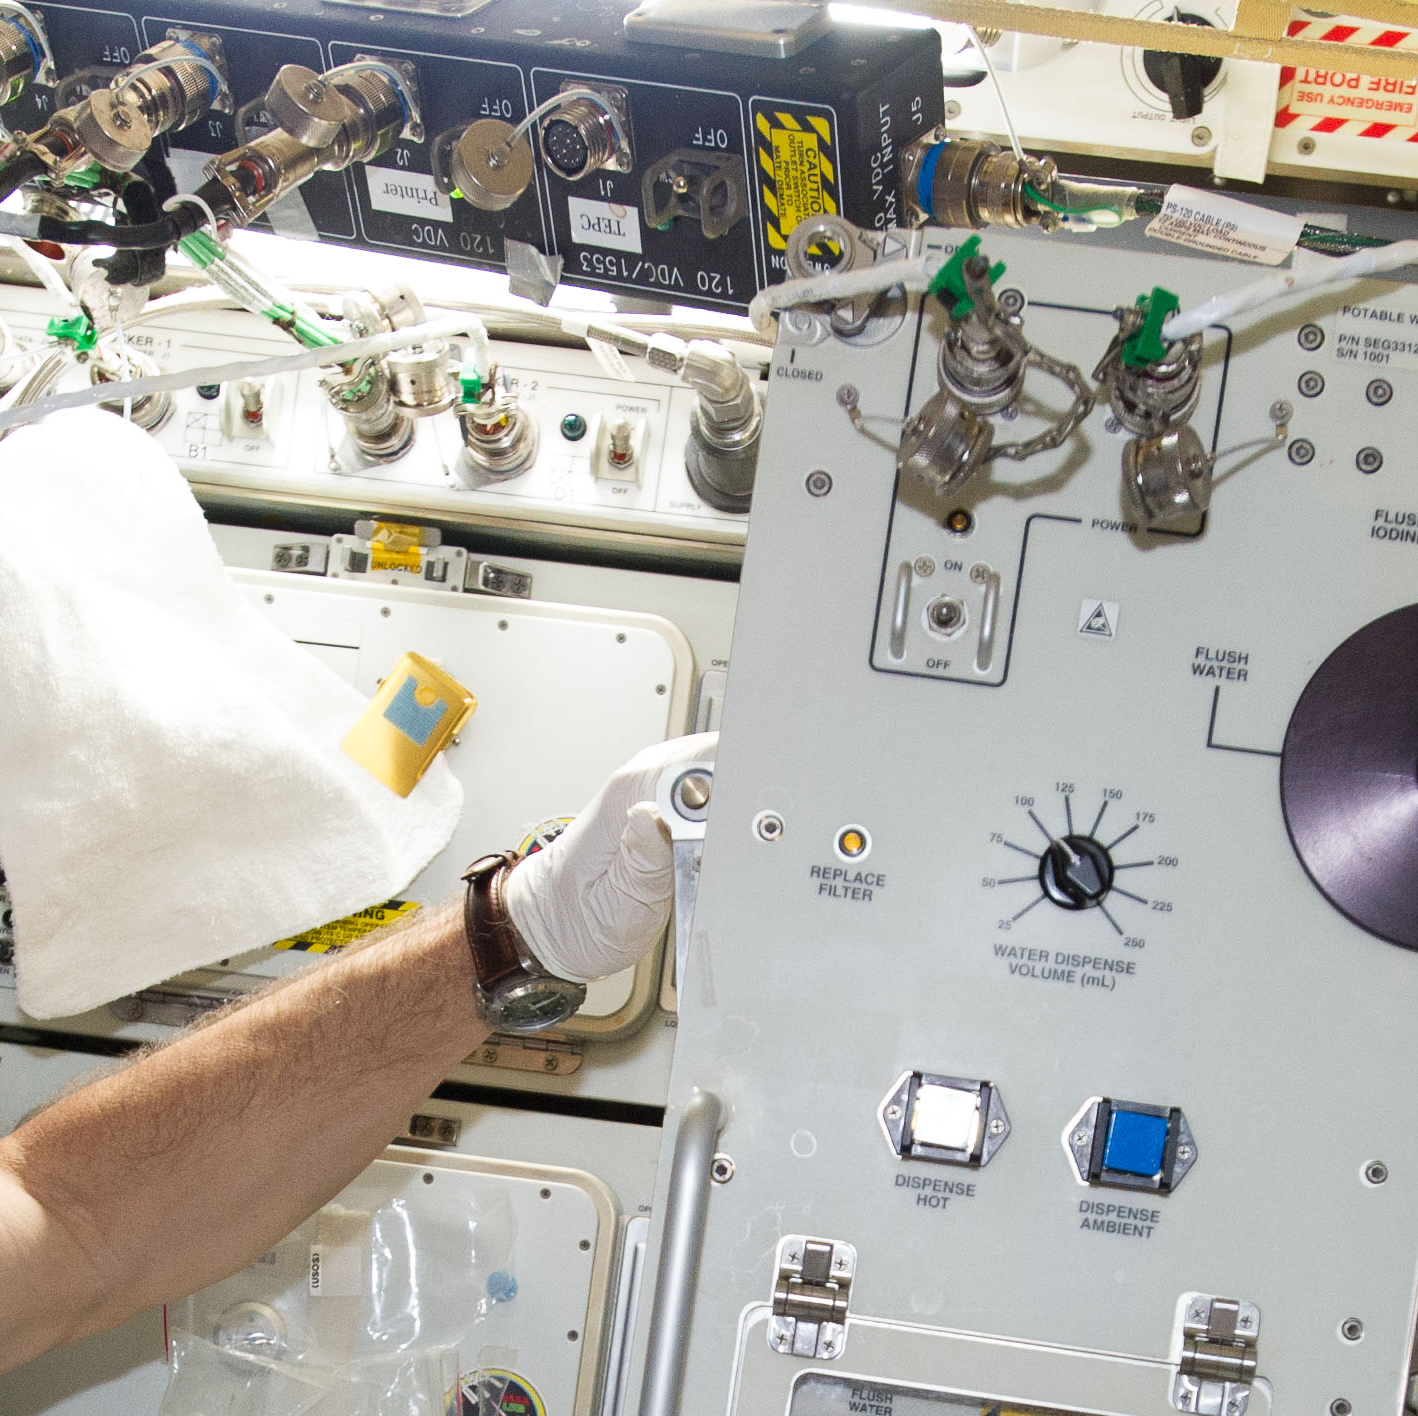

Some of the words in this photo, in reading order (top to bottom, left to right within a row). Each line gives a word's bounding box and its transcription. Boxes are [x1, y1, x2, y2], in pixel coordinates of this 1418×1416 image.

[103, 44, 130, 65] OFF
[1299, 67, 1361, 90] PORT
[1295, 90, 1325, 106] USE
[1328, 97, 1414, 114] EMERGENCY
[480, 97, 512, 119] OFF
[911, 96, 923, 125] J5
[691, 127, 728, 149] OFF
[879, 103, 894, 174] INPUT
[395, 148, 410, 165] J2
[871, 152, 883, 200] VDC
[382, 181, 439, 207] Printer
[599, 179, 614, 197] J1
[1165, 202, 1193, 219] PS-120
[1193, 211, 1222, 229] CABLE
[580, 214, 626, 237] TEPC
[411, 223, 449, 248] VDC
[459, 232, 495, 255] 120
[579, 252, 684, 287] VDC/1553
[697, 270, 735, 295] 120
[1342, 306, 1405, 324] POTABLE
[1338, 333, 1360, 347] P/N
[1336, 346, 1358, 360] S/N
[1362, 350, 1391, 364] 1001
[775, 367, 823, 382] CLOSED
[1090, 518, 1139, 535] POWER
[943, 559, 964, 572] ON
[925, 657, 953, 673] OFF
[1193, 647, 1250, 667] FLUSH
[1191, 662, 1250, 684] WATER
[1053, 782, 1075, 795] 125
[1101, 788, 1124, 802] 150
[1013, 794, 1036, 809] 100
[1133, 811, 1157, 825] 175
[988, 832, 1005, 845] 75
[1156, 855, 1180, 869] 200
[809, 864, 887, 888] REPLACE
[981, 876, 997, 889] 50
[817, 883, 874, 902] FILTER
[1151, 900, 1174, 914] 225
[997, 919, 1013, 932] 25
[1123, 936, 1146, 950] 250
[992, 943, 1050, 966] WATER
[1054, 951, 1137, 977] DISPENSE
[1008, 962, 1077, 985] VOLUME
[1080, 970, 1118, 992] (mL)
[893, 1172, 977, 1198] DISPENSE
[915, 1193, 952, 1212] HOT
[1078, 1199, 1161, 1224] DISPENSE
[1079, 1217, 1155, 1240] AMBIENT
[311, 1251, 321, 1290] (USOS)
[850, 1387, 894, 1406] FLUSH
